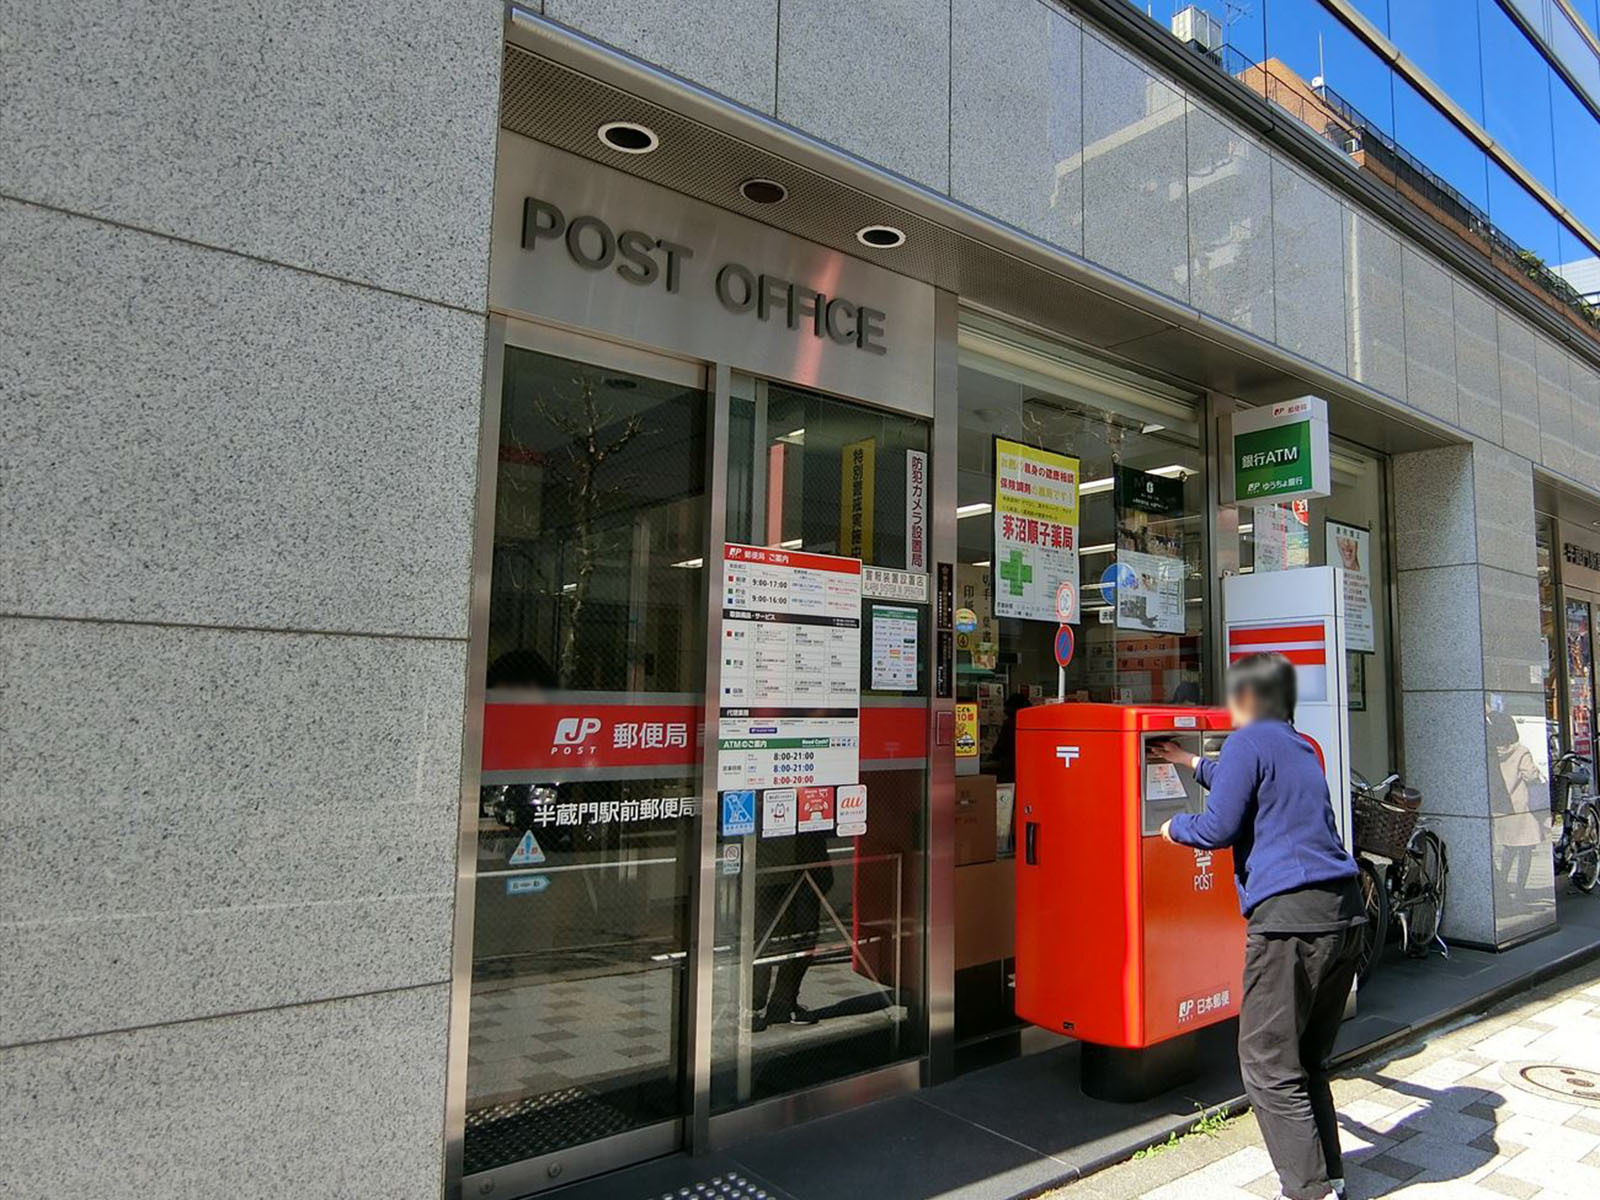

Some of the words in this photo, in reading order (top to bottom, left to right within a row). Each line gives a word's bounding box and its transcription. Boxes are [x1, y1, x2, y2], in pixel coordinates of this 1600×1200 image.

[521, 196, 693, 294] POST
[715, 263, 887, 355] OFFICE
[1241, 446, 1298, 469] 銀行ATM
[1262, 476, 1303, 490] ゆうちょ銀行
[911, 456, 923, 568] 防犯カメラ設置局
[1003, 515, 1073, 551] 茅沼順子薬局
[768, 553, 789, 564] ご案内
[752, 579, 788, 589] 9:00-17:00
[752, 595, 788, 605] 9:00-16:00
[613, 722, 688, 749] 郵便局
[551, 746, 597, 755] POST
[773, 751, 815, 761] 8:00-21:00
[773, 763, 815, 773] 8:00-21:00
[773, 775, 815, 785] 8:00-20:00
[841, 796, 864, 809] au
[533, 797, 697, 828] 半蔵門駅前郵便局
[1194, 873, 1214, 891] POST
[1197, 990, 1230, 1015] 日本郵便
